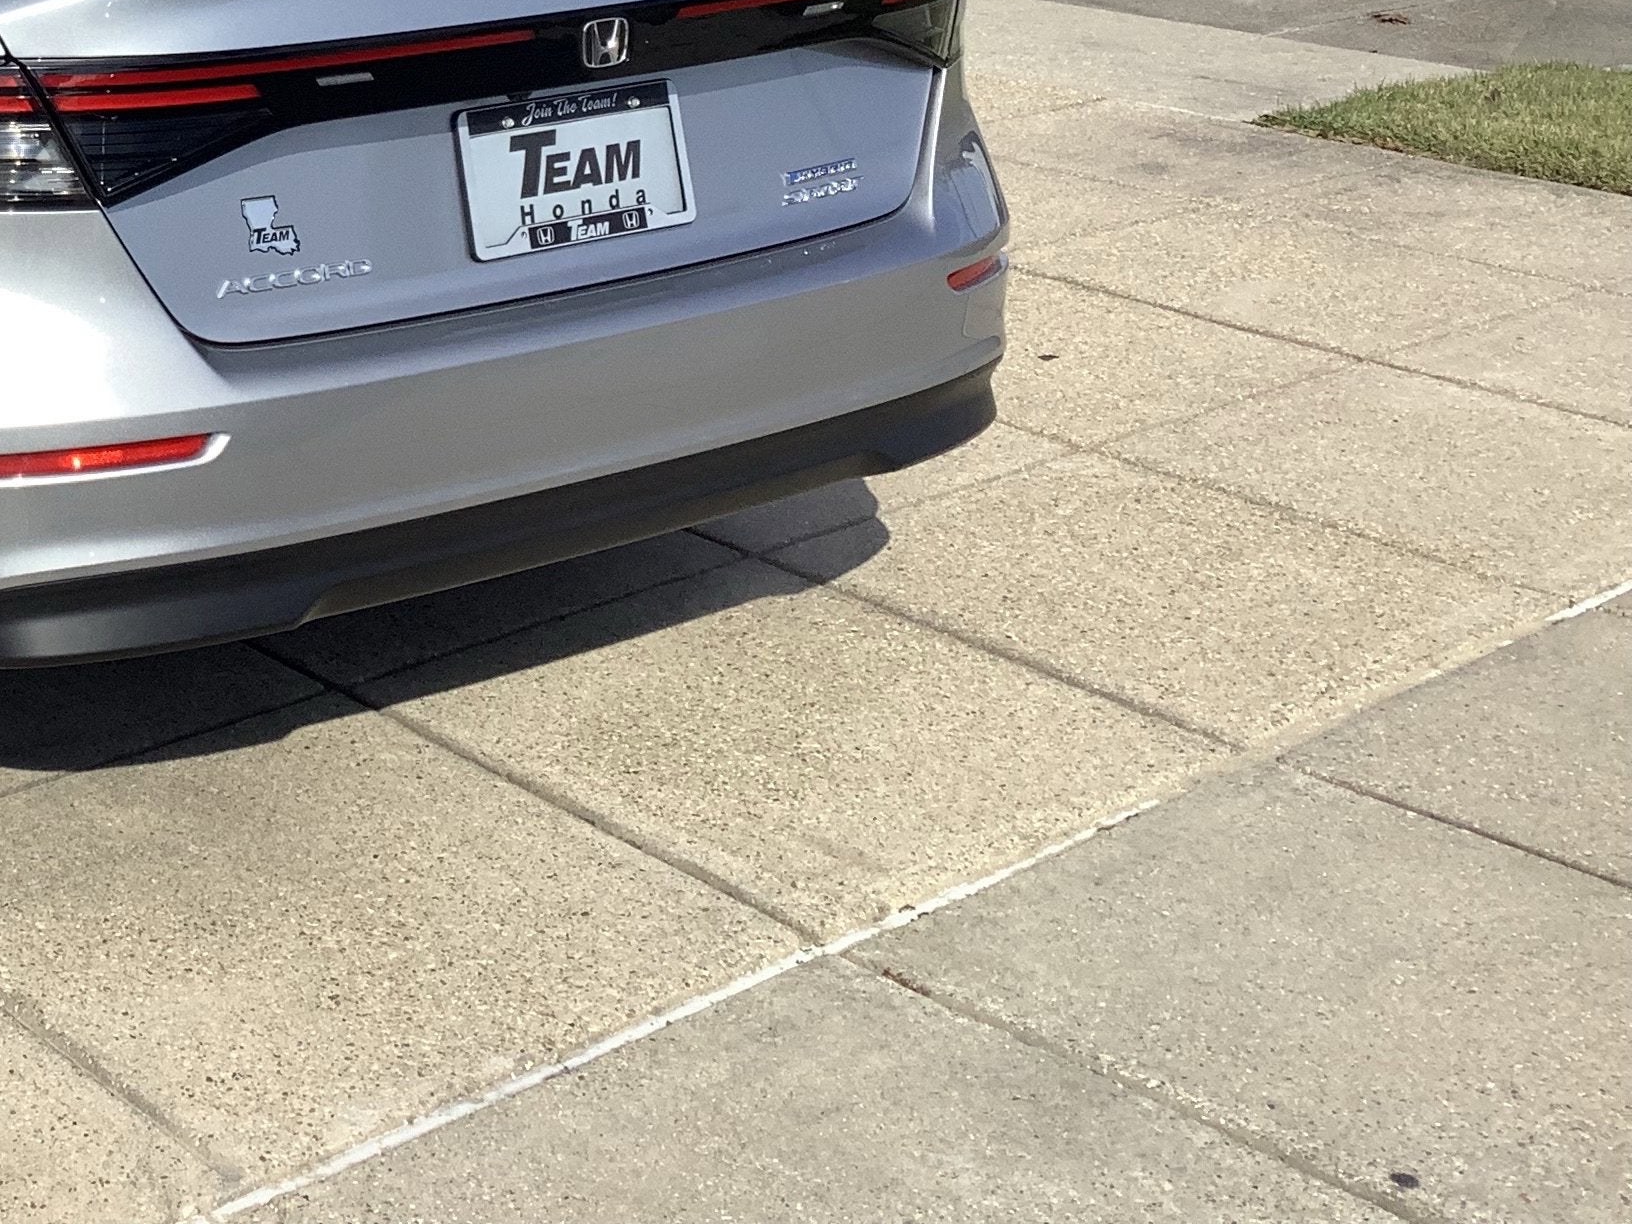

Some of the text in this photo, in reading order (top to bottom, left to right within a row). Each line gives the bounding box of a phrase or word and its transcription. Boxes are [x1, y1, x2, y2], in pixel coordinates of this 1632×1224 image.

[522, 93, 617, 126] Join The Team!
[509, 129, 641, 200] TEAM
[520, 188, 647, 226] Honda
[253, 228, 290, 244] TEAM
[567, 218, 610, 241] TEAM
[217, 259, 372, 299] ACCORD
